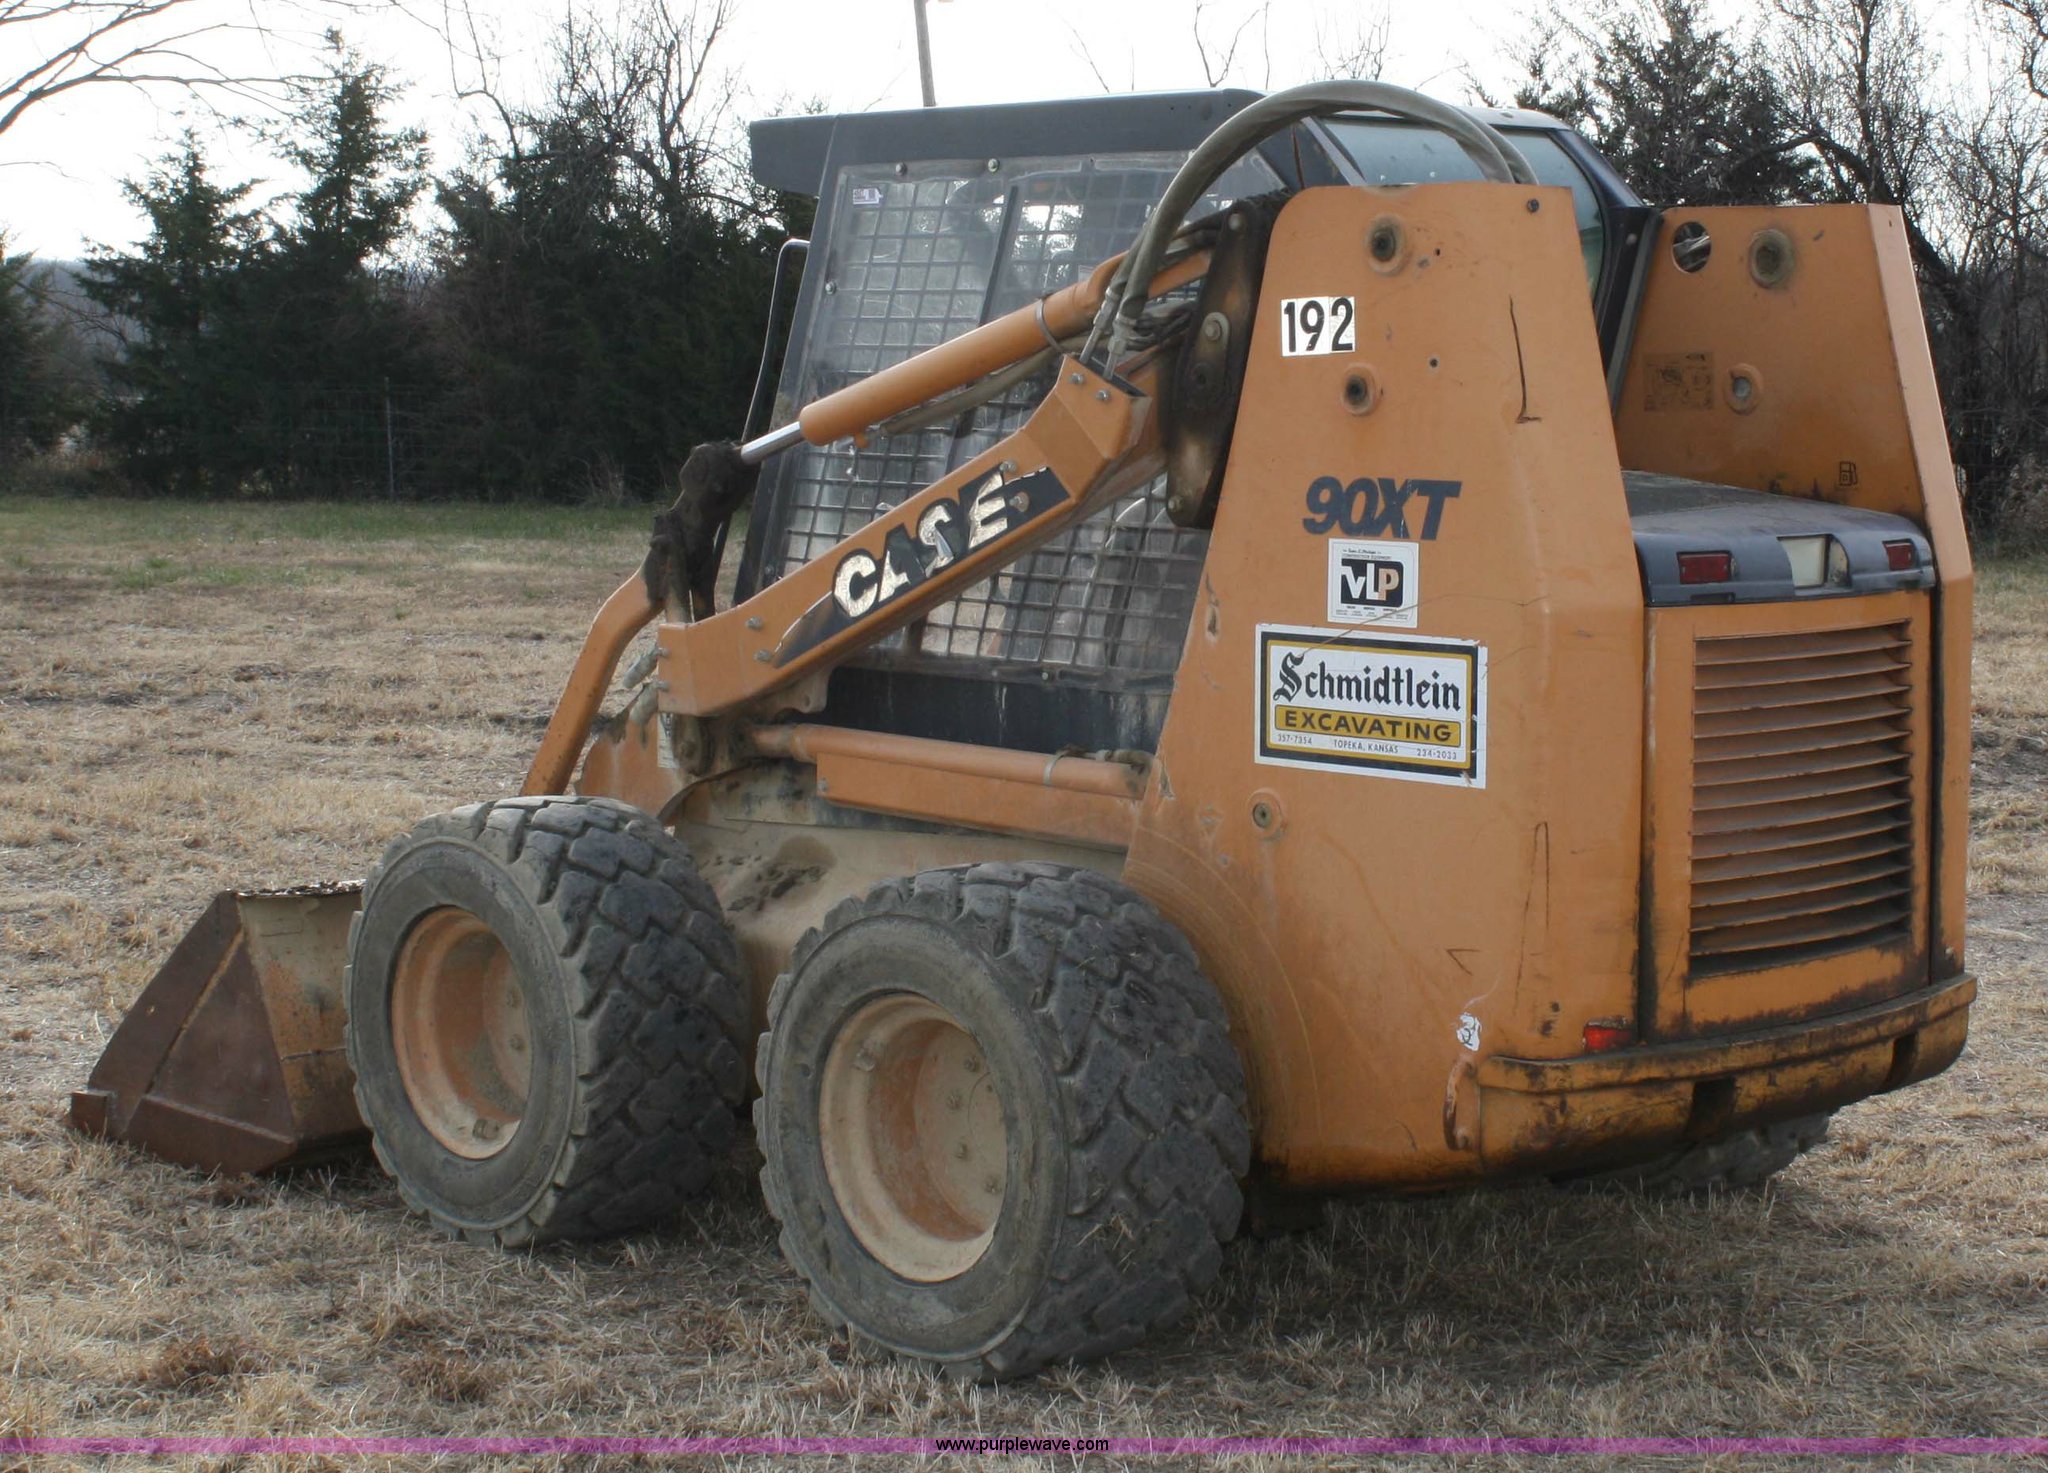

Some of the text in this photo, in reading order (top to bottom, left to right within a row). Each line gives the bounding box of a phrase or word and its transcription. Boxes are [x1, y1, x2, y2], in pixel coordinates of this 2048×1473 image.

[1284, 297, 1353, 352] 192
[1303, 475, 1462, 540] 90XT
[833, 472, 1008, 618] CASE
[1272, 651, 1461, 711] Schmidtlein
[1285, 710, 1451, 742] EXCAVATING
[1367, 744, 1399, 754] KANSAS
